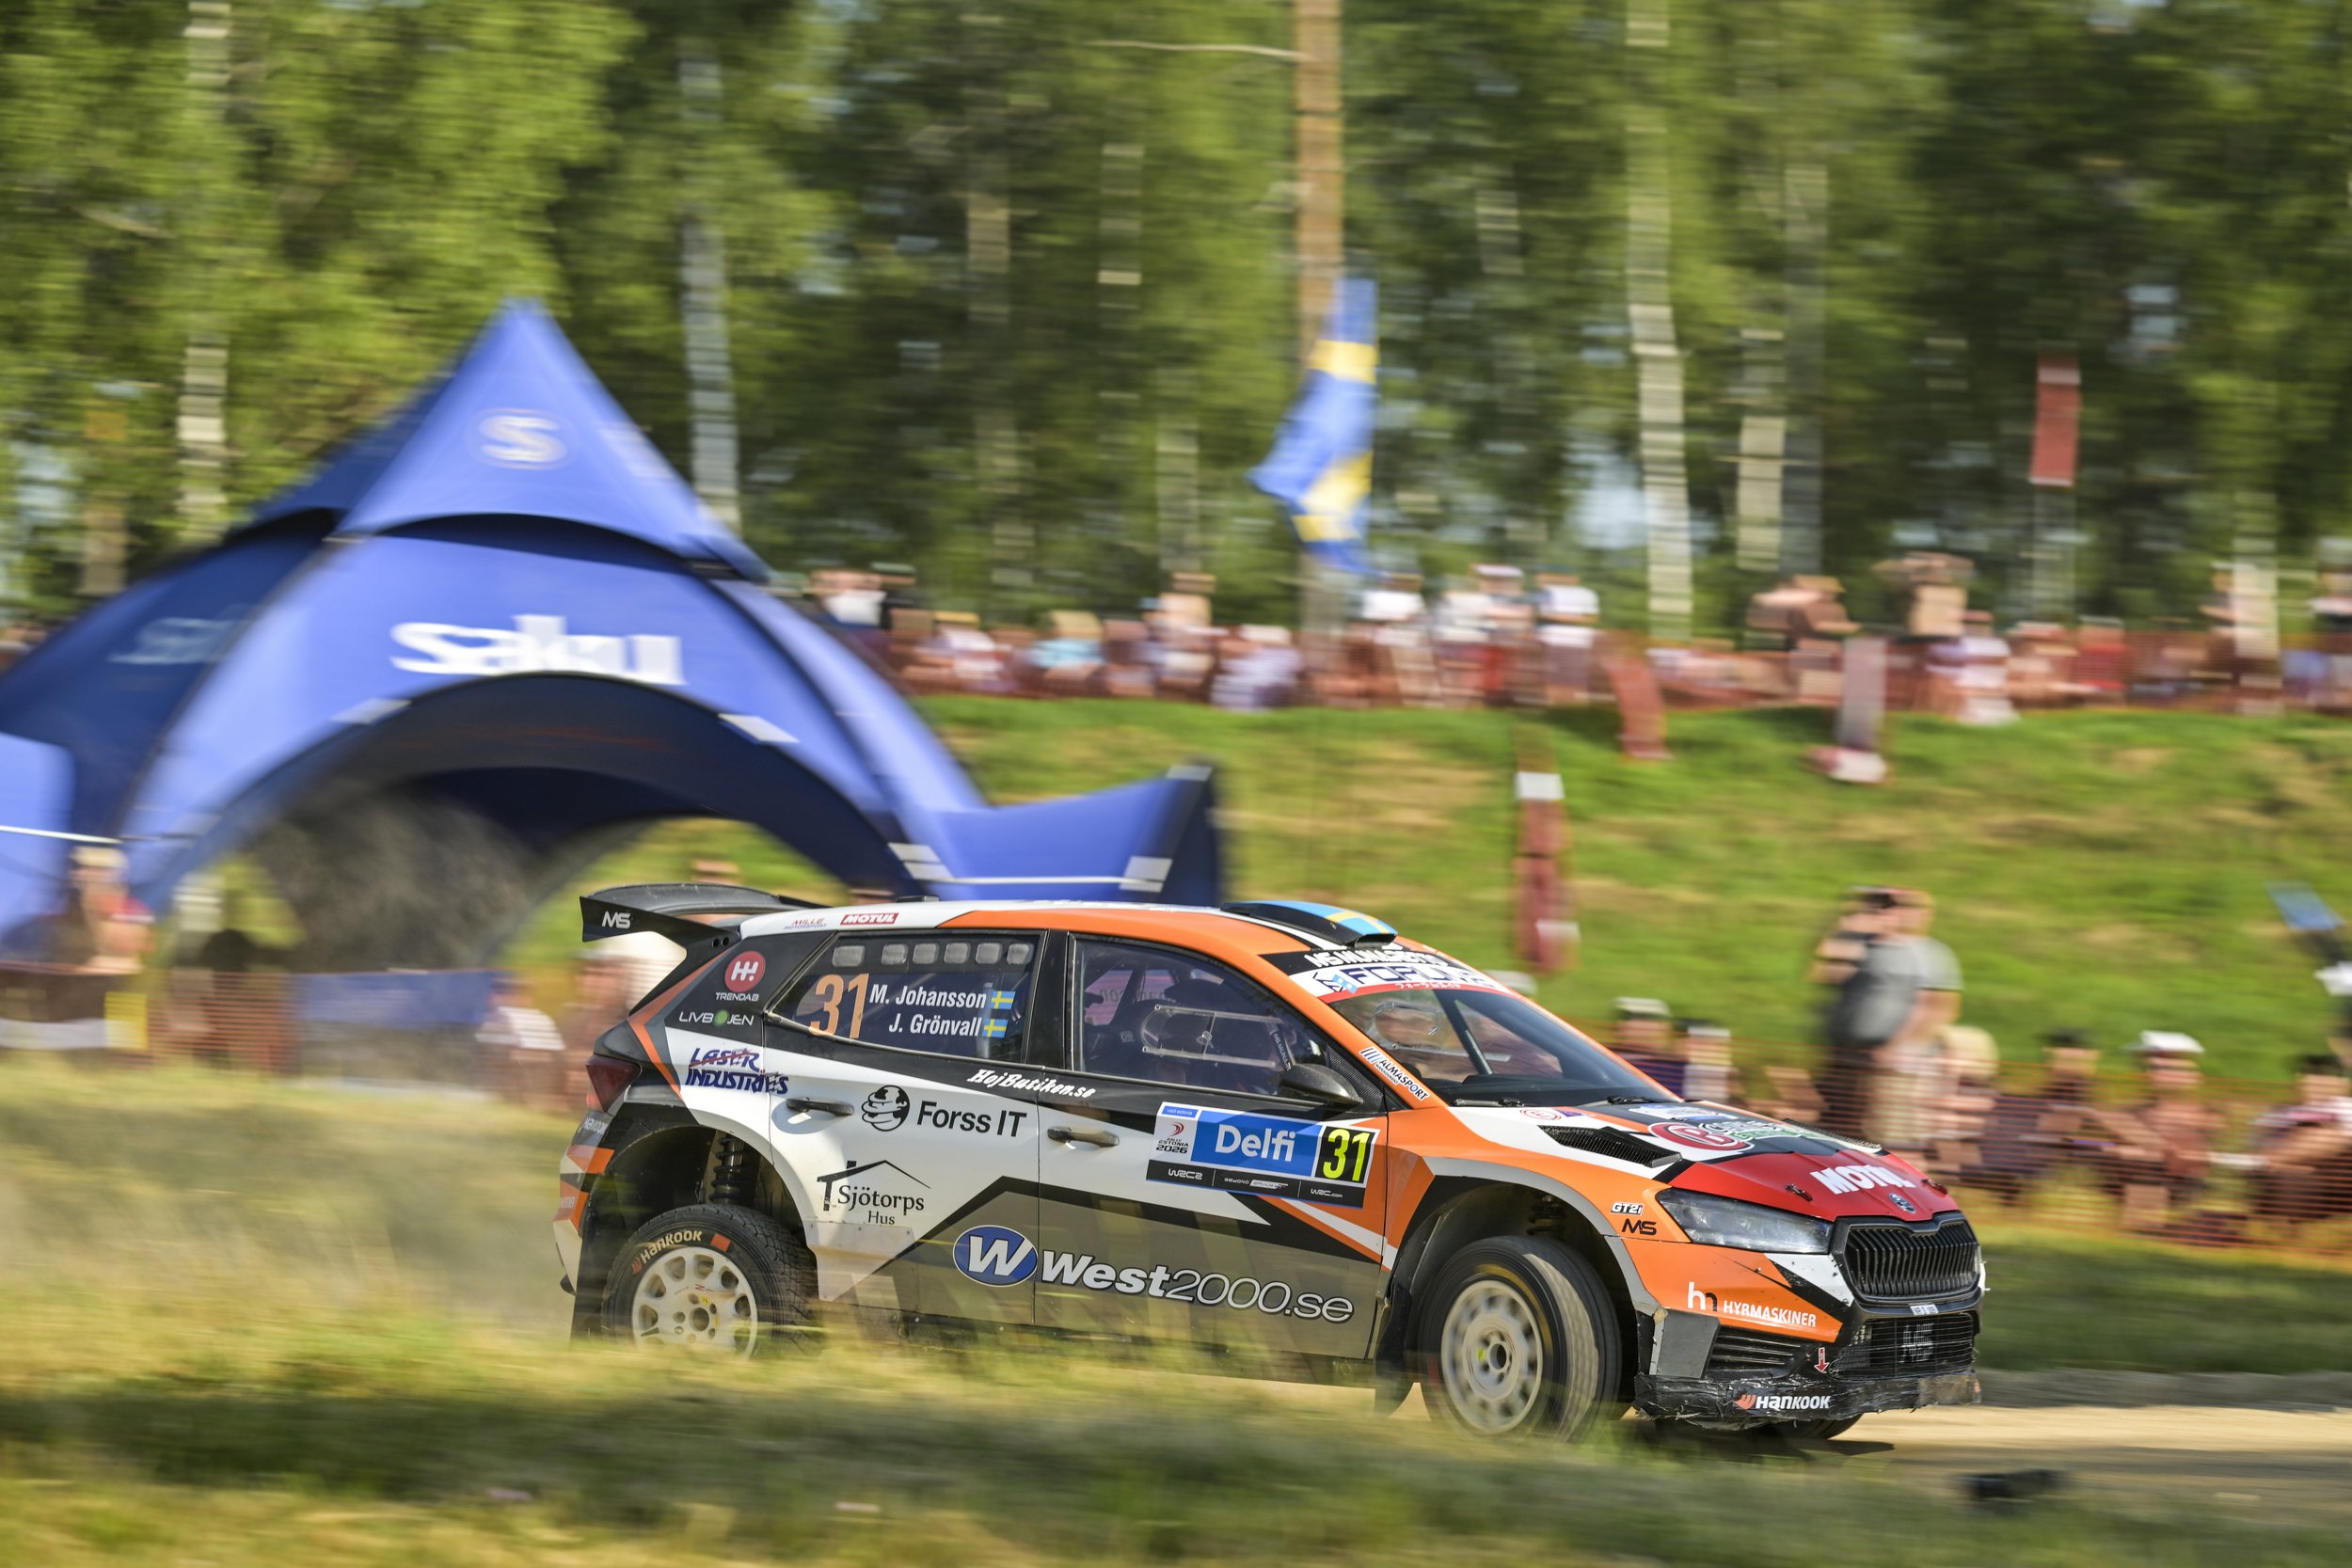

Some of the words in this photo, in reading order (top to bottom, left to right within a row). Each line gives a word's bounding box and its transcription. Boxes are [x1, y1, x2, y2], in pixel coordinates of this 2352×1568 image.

[602, 911, 631, 929] MS
[842, 912, 897, 925] MOTUL
[809, 972, 870, 1038] 31
[869, 984, 890, 1005] M.
[895, 986, 987, 1009] Johansson
[888, 1013, 903, 1033] J.
[910, 1013, 983, 1037] Grönvall
[685, 1068, 789, 1095] INDUSTRIES
[1379, 1059, 1428, 1100] ALMASPORT
[916, 1101, 993, 1134] Forss
[996, 1110, 1027, 1137] IT
[1215, 1124, 1296, 1163] Delfi
[1322, 1128, 1371, 1182] 31
[837, 1184, 925, 1216] Sjötorps
[867, 1210, 896, 1226] Hus
[1621, 1218, 1658, 1236] MS
[1041, 1249, 1355, 1323] West2000.se
[1723, 1300, 1817, 1327] HYRMASKINER
